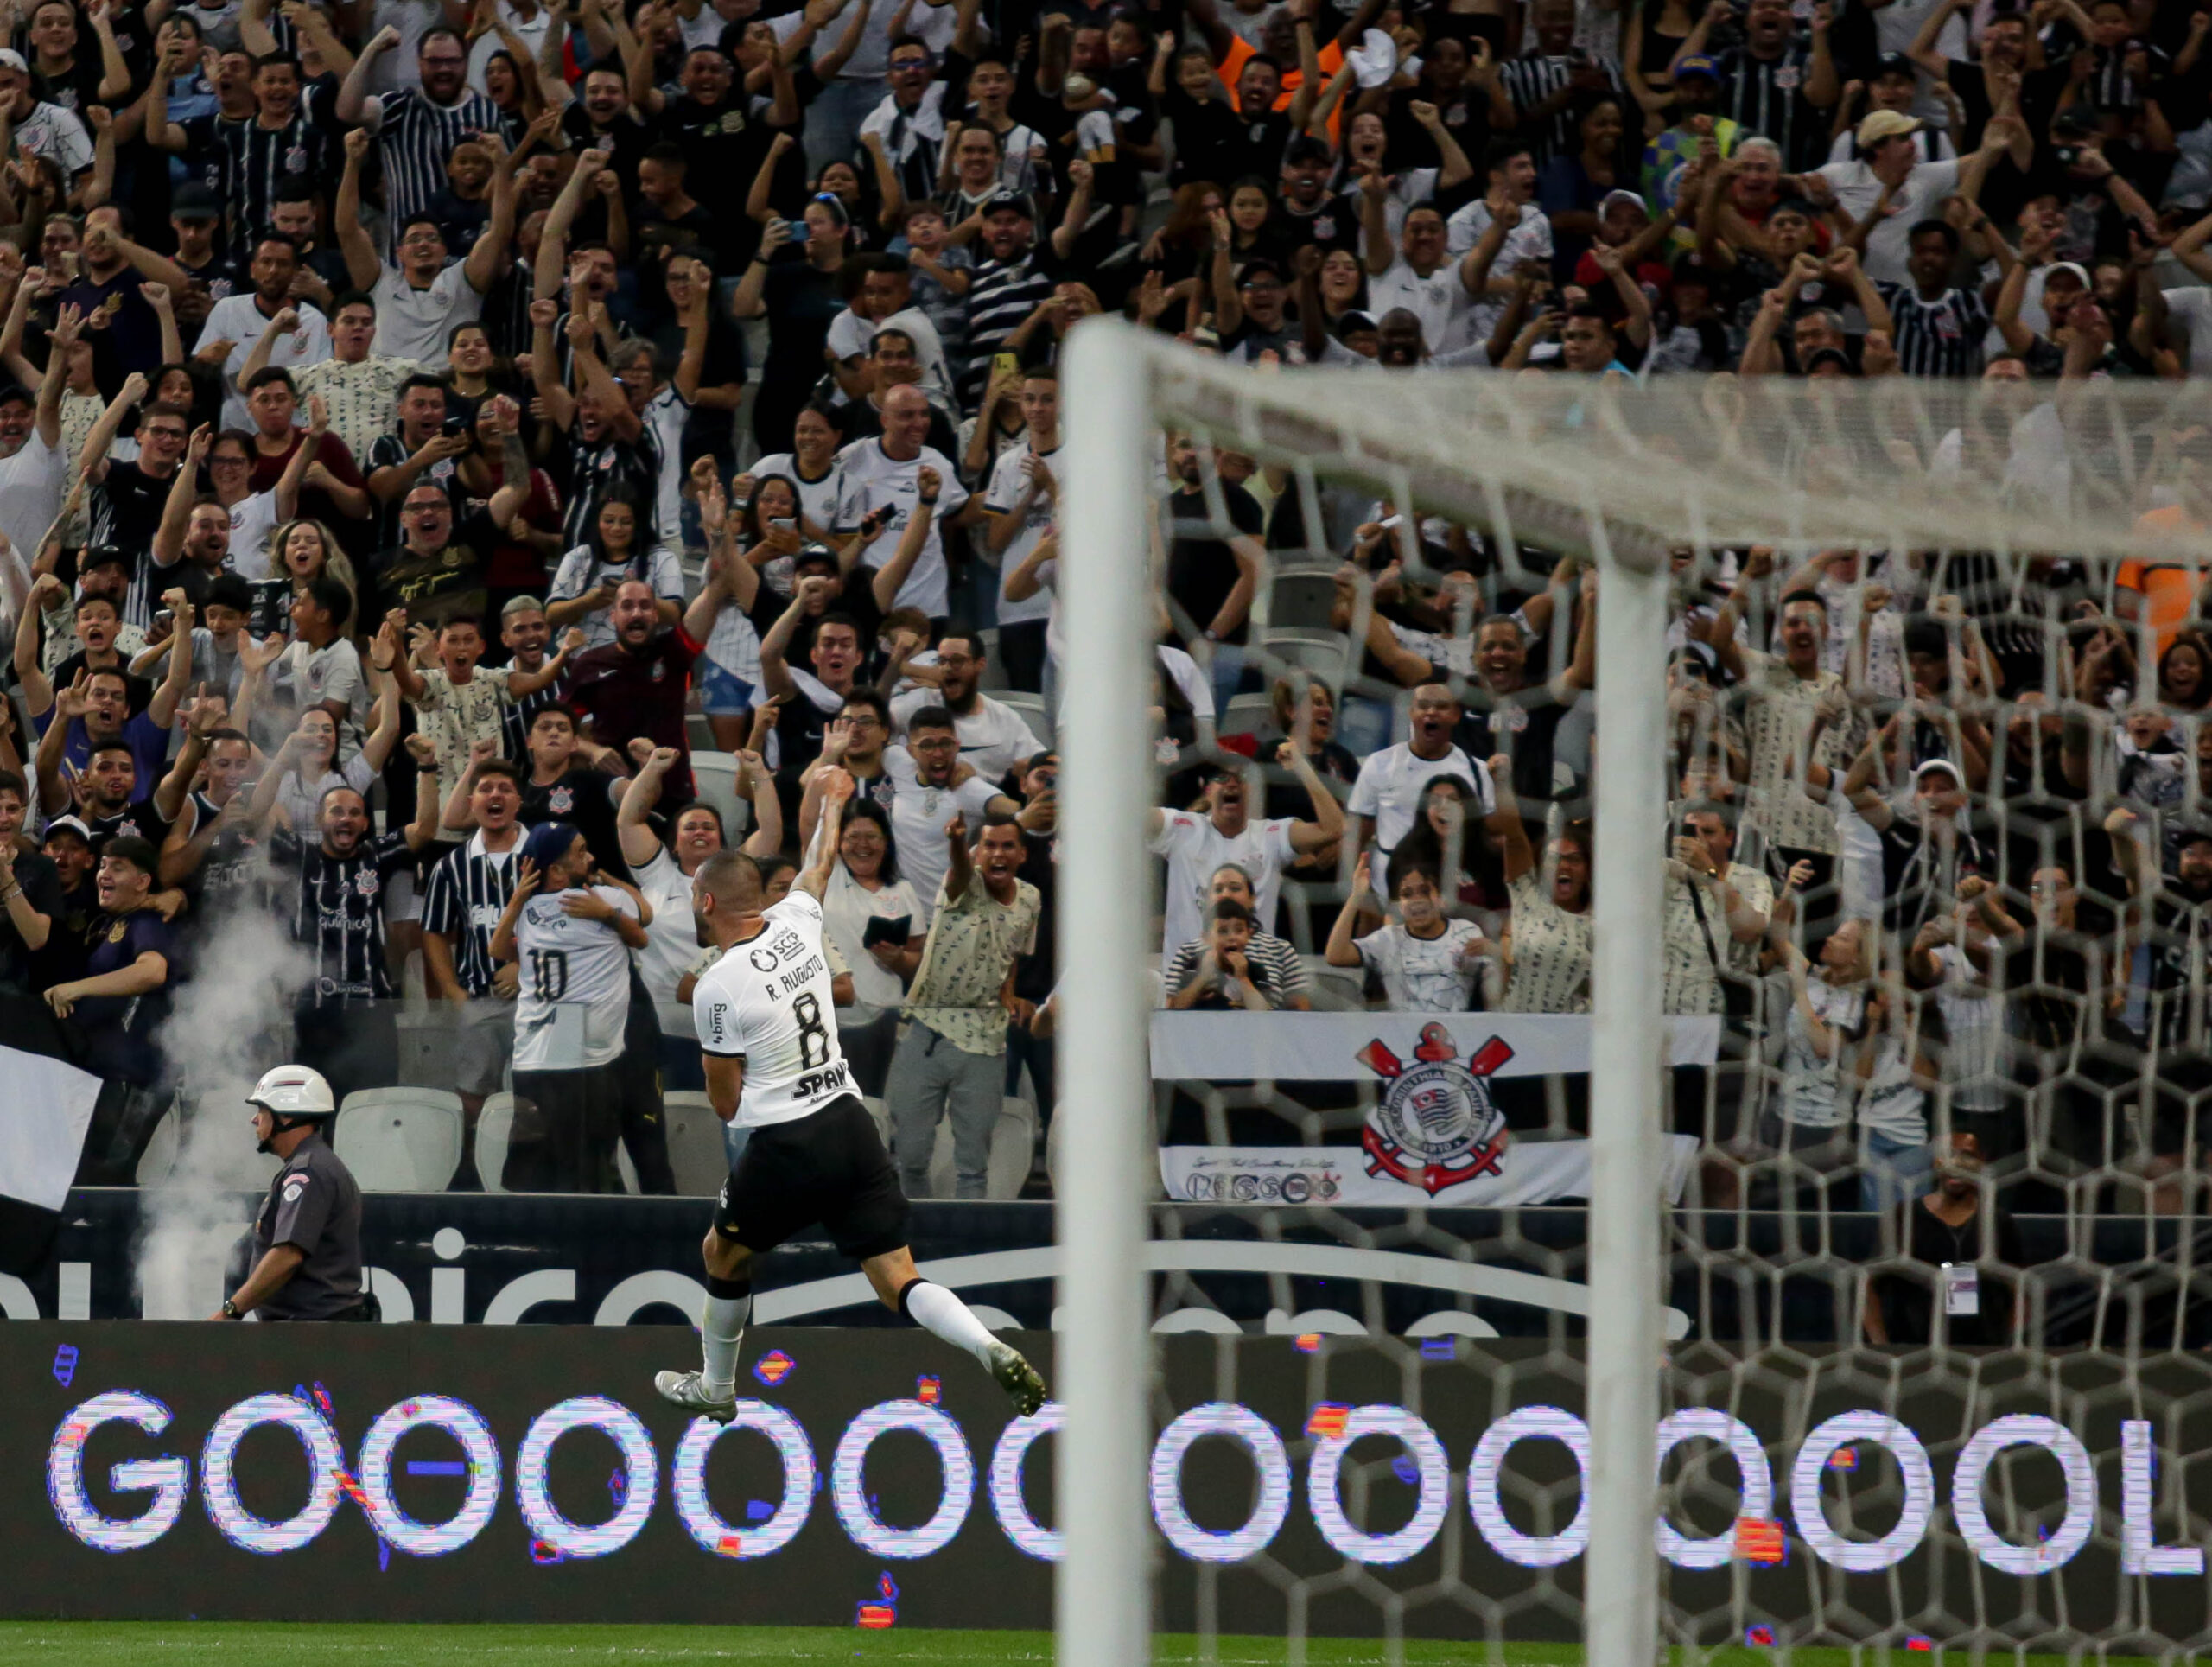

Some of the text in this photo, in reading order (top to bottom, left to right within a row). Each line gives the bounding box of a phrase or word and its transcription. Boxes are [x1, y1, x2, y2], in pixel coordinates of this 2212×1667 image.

[773, 932, 800, 954] SCCP
[527, 949, 569, 1002] 10
[765, 953, 823, 1002] R. AUGUSTO
[711, 1002, 728, 1035] bmg
[793, 992, 830, 1072] 8
